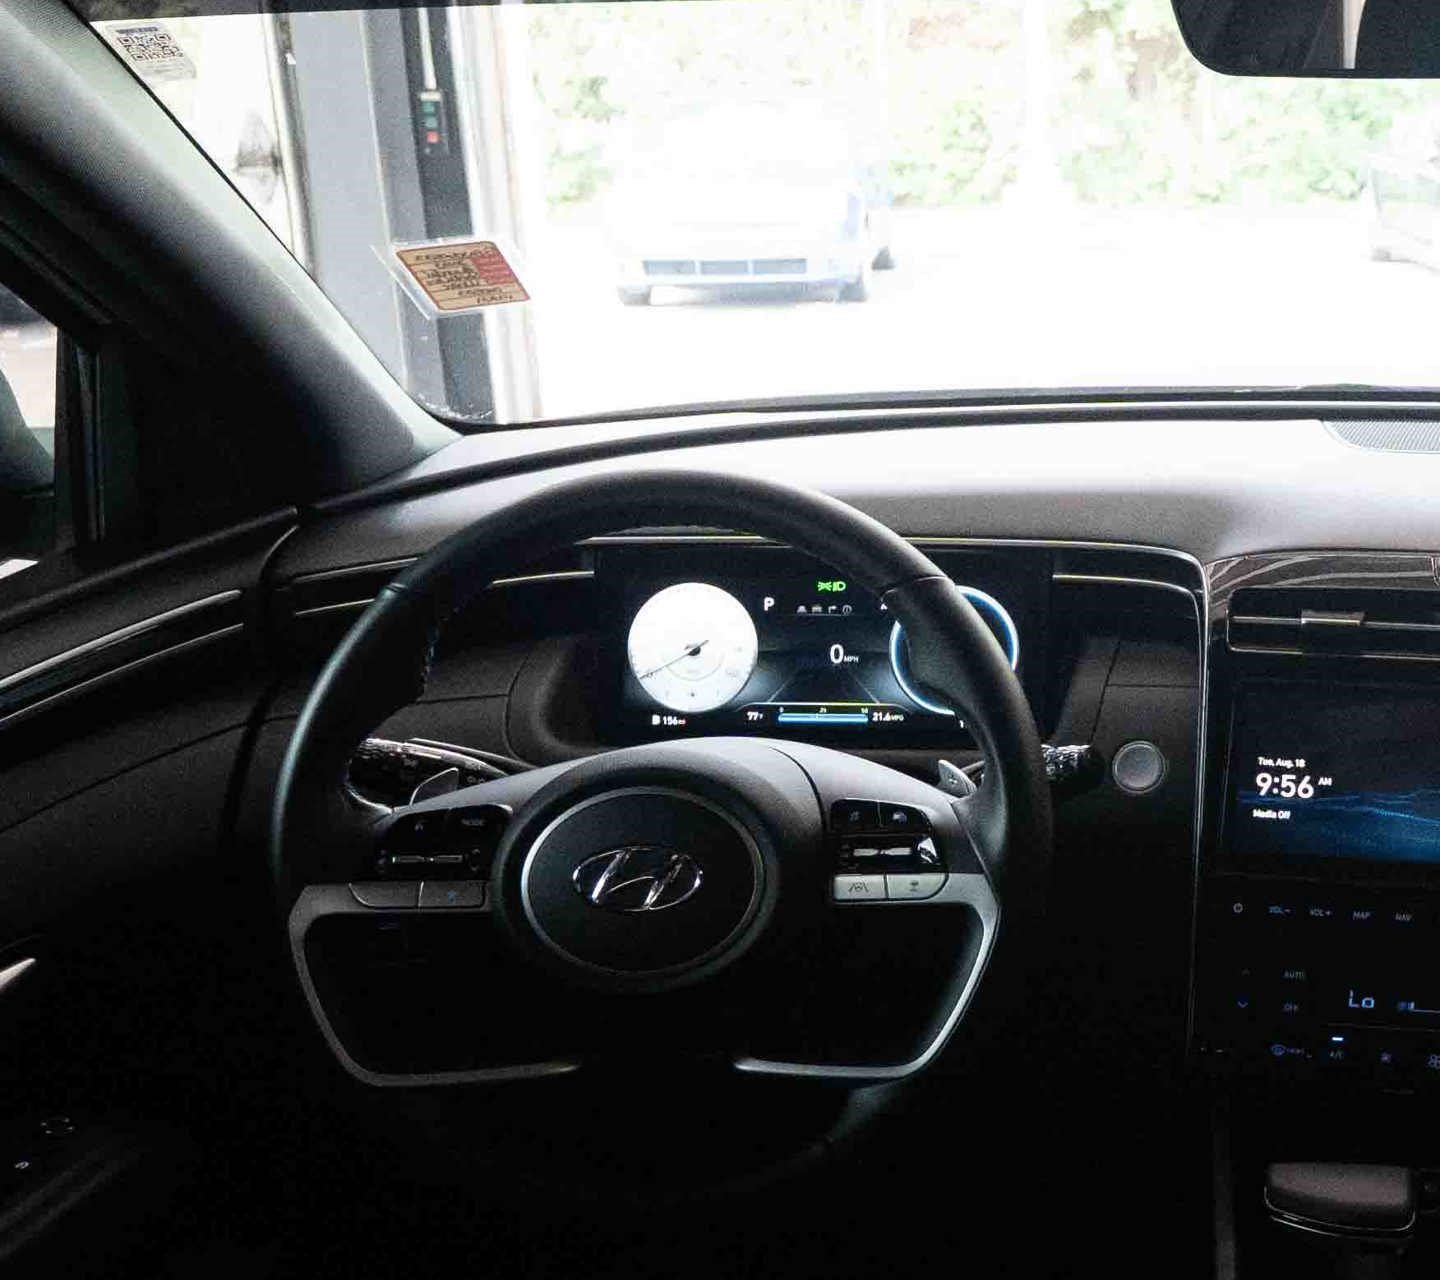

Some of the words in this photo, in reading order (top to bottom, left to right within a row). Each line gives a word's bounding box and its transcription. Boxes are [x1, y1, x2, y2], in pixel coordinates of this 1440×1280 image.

[763, 596, 775, 611] P
[1256, 772, 1315, 799] 9:56
[1318, 776, 1333, 786] AM
[1252, 809, 1277, 819] Media
[1278, 810, 1291, 819] Off
[1348, 988, 1376, 1009] Lo
